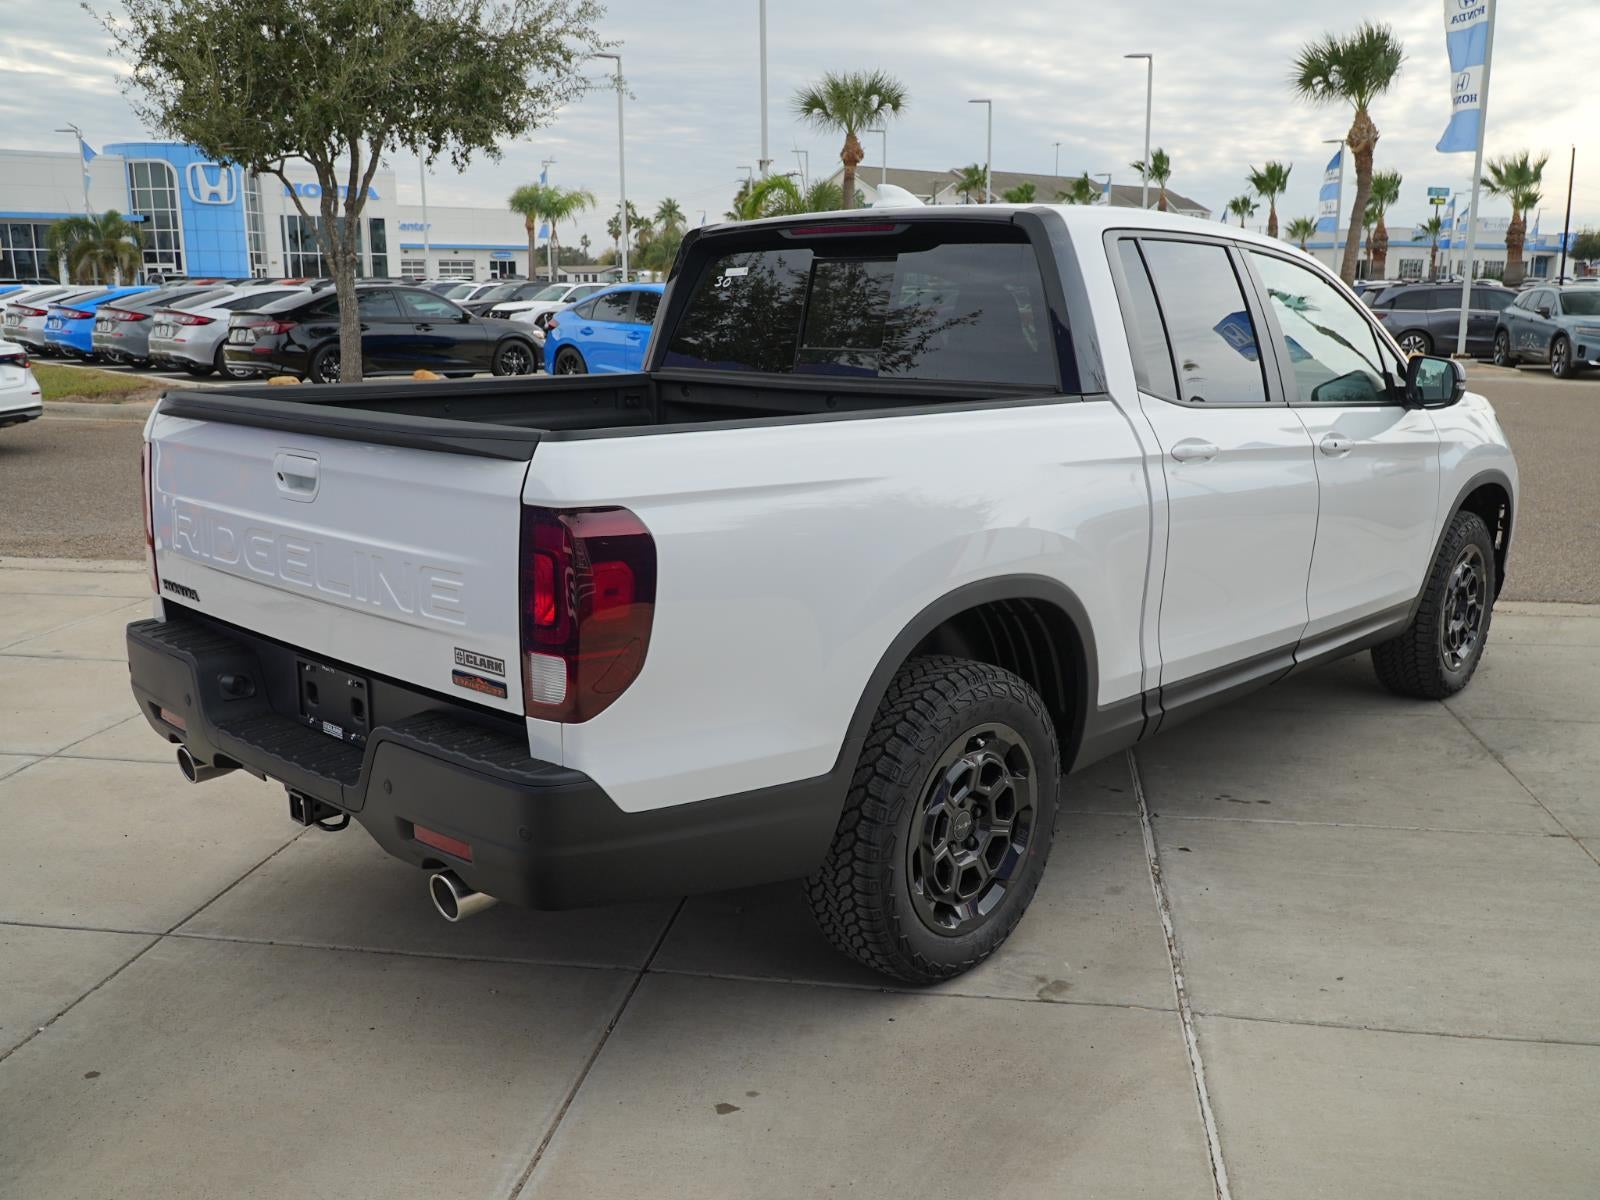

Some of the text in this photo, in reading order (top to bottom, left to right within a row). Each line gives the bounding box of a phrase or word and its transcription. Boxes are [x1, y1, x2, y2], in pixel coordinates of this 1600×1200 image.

[714, 276, 731, 287] 30
[173, 507, 466, 626] RIDGELINE
[465, 653, 503, 673] CLARK
